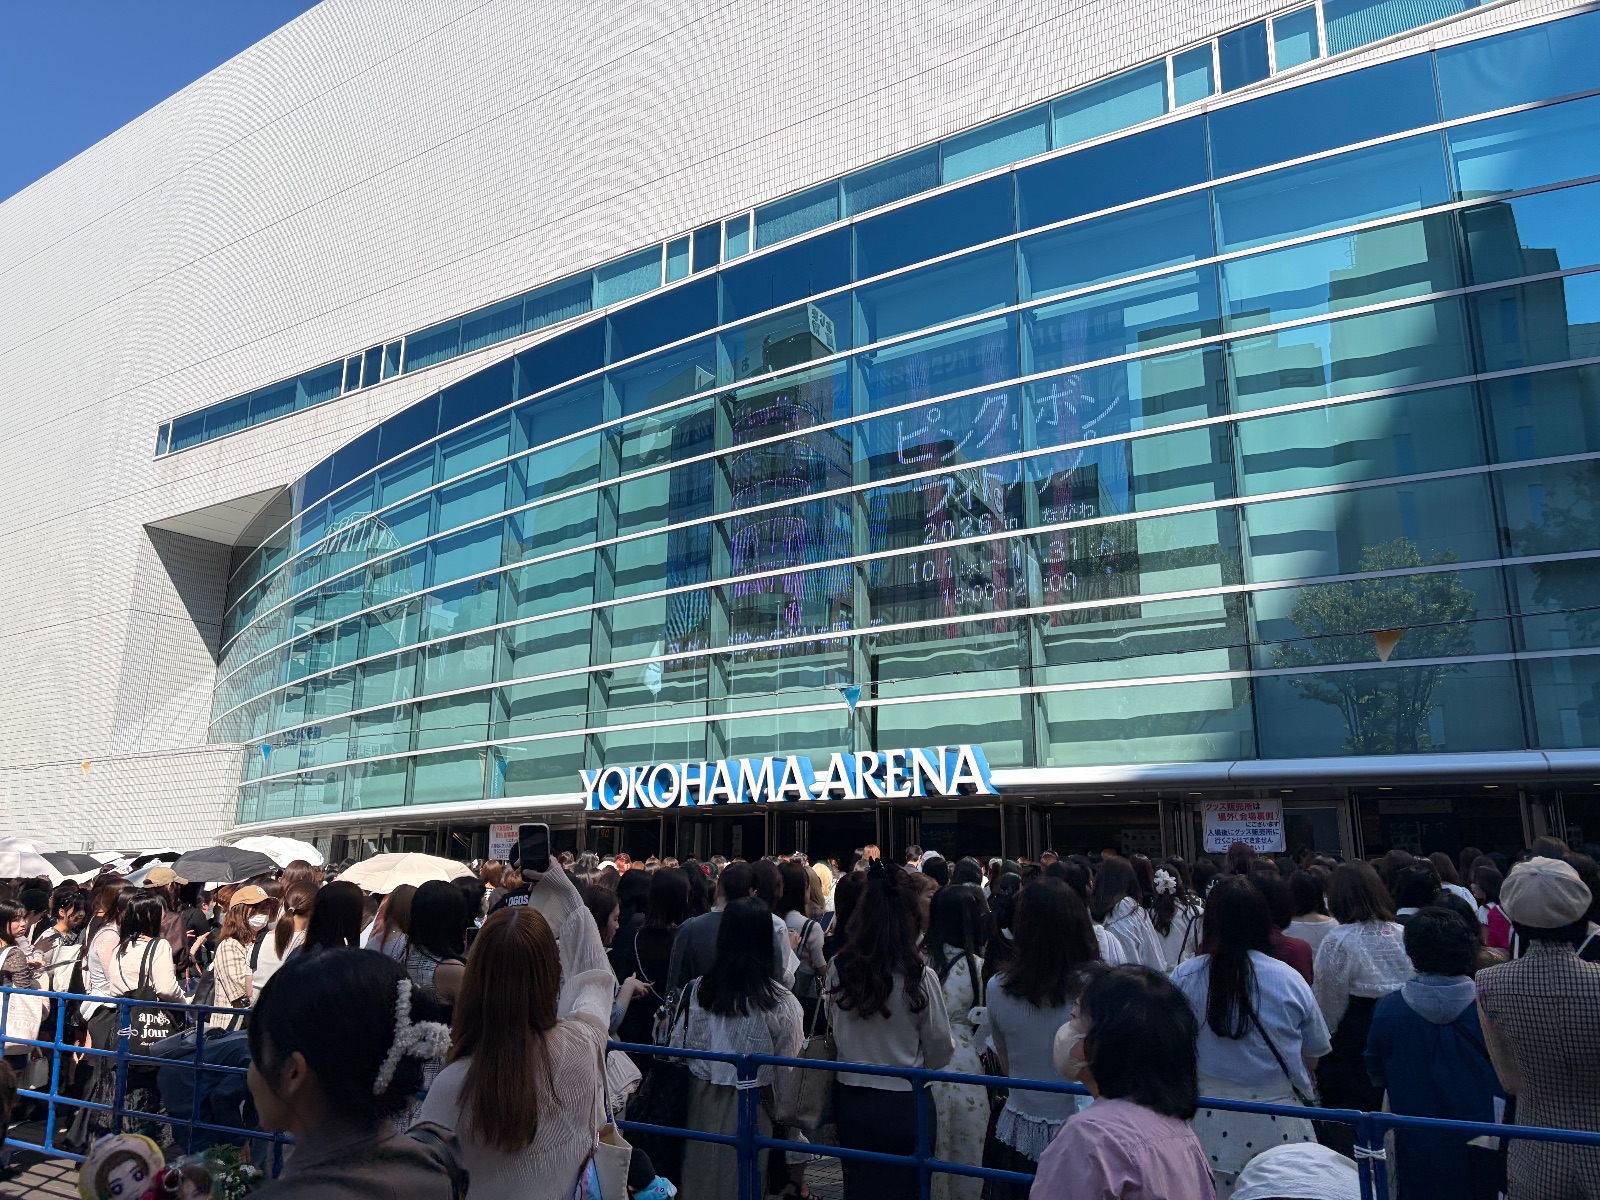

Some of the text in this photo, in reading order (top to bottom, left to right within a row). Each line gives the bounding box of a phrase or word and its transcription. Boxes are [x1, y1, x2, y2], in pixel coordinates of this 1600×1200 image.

[578, 744, 996, 811] YOKOHAMA ARENA
[1205, 802, 1261, 811] グッズ販売所は
[1207, 828, 1280, 837] 入場後にグッズ販売所に
[505, 894, 529, 907] OGOS
[140, 1025, 169, 1039] jour
